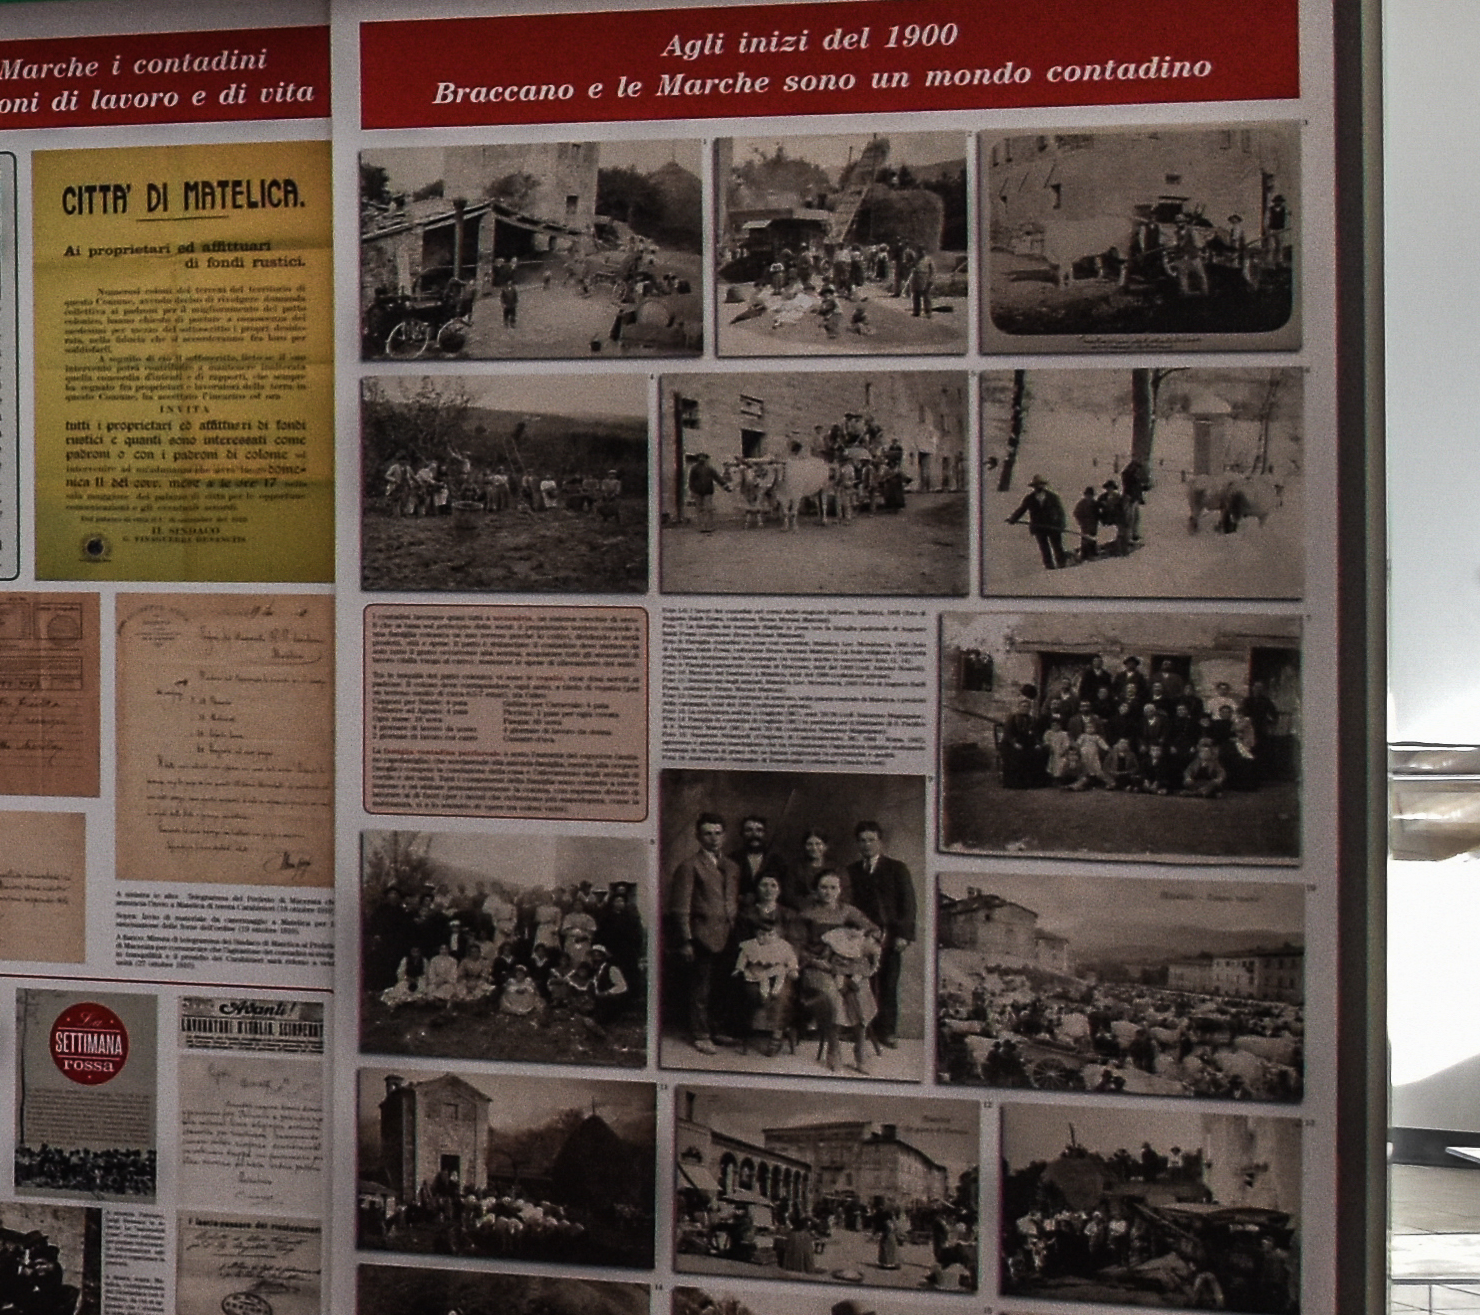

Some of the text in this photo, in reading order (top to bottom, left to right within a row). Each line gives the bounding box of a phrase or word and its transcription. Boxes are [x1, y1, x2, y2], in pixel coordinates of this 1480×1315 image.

[661, 23, 958, 60] Agli inizi del 1900
[111, 54, 121, 75] i
[133, 48, 267, 74] contadini
[432, 55, 1212, 104] Braccano e le Marche sono un mondo contadino
[51, 90, 78, 111] di
[91, 89, 178, 110] lavoro
[191, 90, 206, 106] e
[218, 83, 247, 105] di
[260, 81, 313, 103] vita
[62, 178, 305, 215] CITTA' DI MATELICA.
[55, 1030, 122, 1057] SETTIMANA
[63, 1059, 113, 1073] rossa
